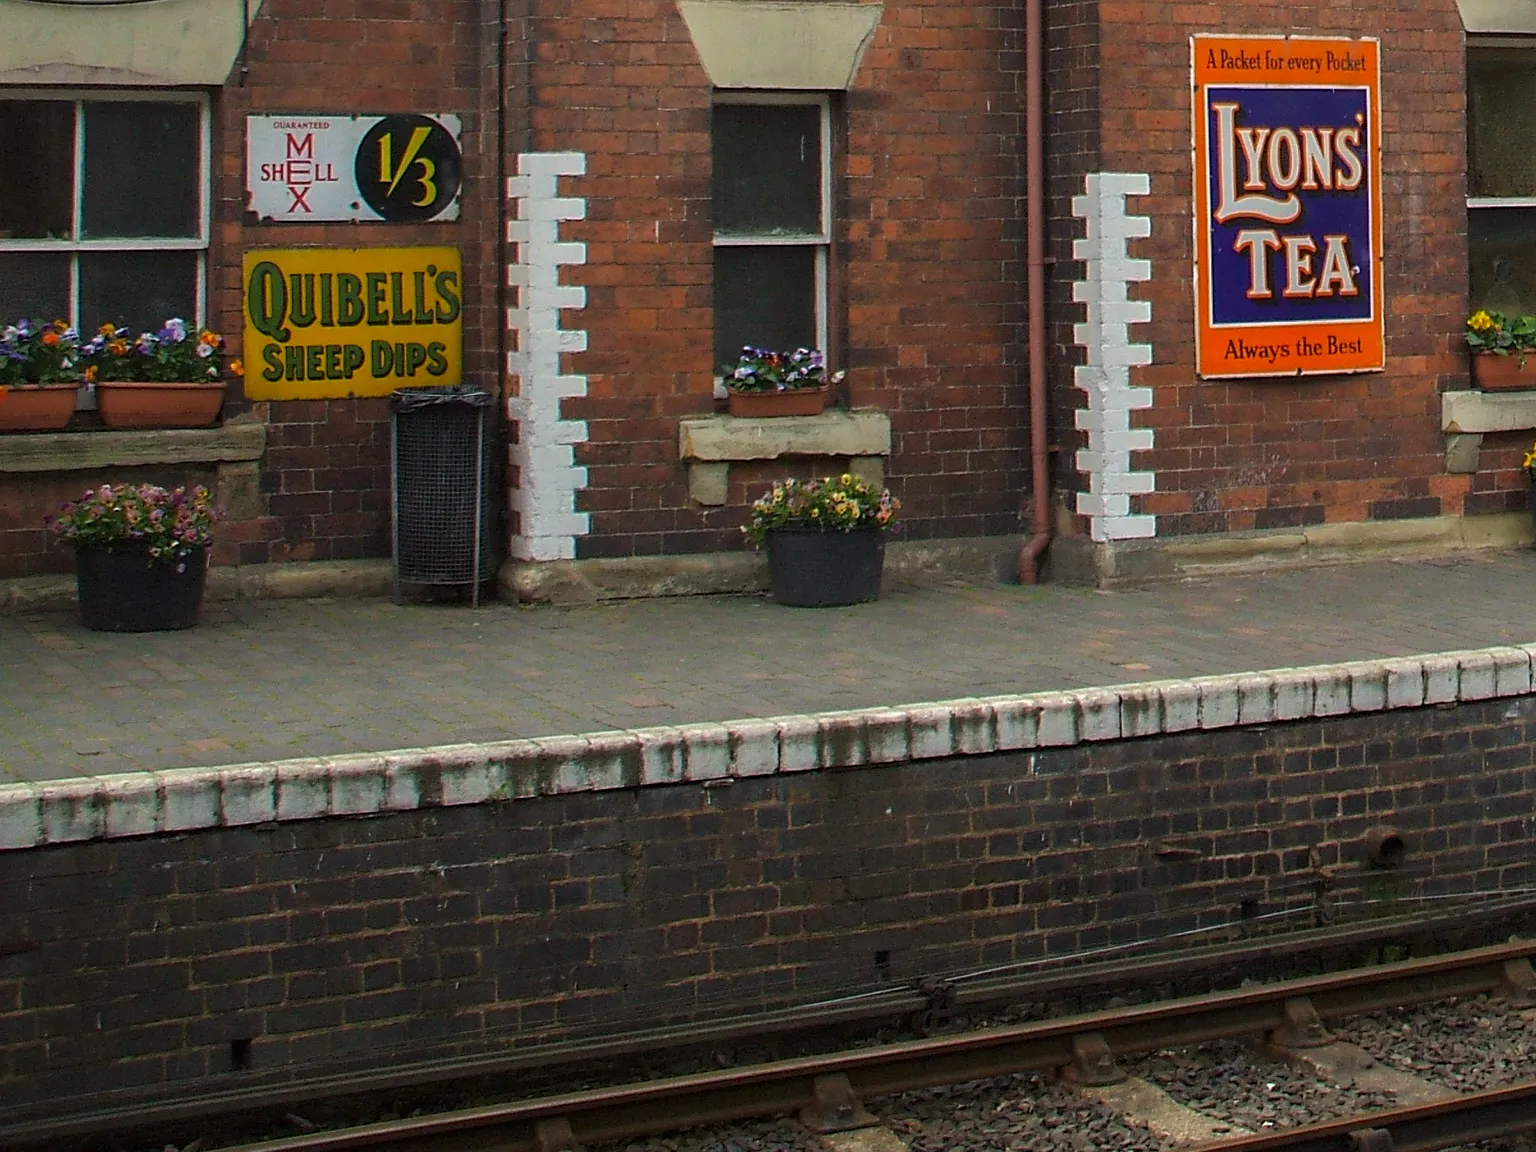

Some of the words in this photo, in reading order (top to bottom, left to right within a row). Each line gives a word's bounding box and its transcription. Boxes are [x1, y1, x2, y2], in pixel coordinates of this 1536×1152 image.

[1207, 49, 1217, 69] A
[1220, 49, 1261, 70] Packet
[1264, 50, 1285, 70] for
[1288, 56, 1322, 75] every
[1326, 51, 1367, 72] Pocket
[273, 121, 330, 130] GUARANTEED
[261, 160, 338, 185] SHELL
[378, 126, 437, 207] 1/3
[1233, 228, 1360, 298] TEA
[248, 261, 461, 343] QUIBELL'S
[261, 343, 365, 382] SHEEP
[371, 339, 448, 379] DIPS
[1225, 337, 1291, 363] Always
[1296, 337, 1322, 357] the
[1327, 335, 1363, 356] Best
